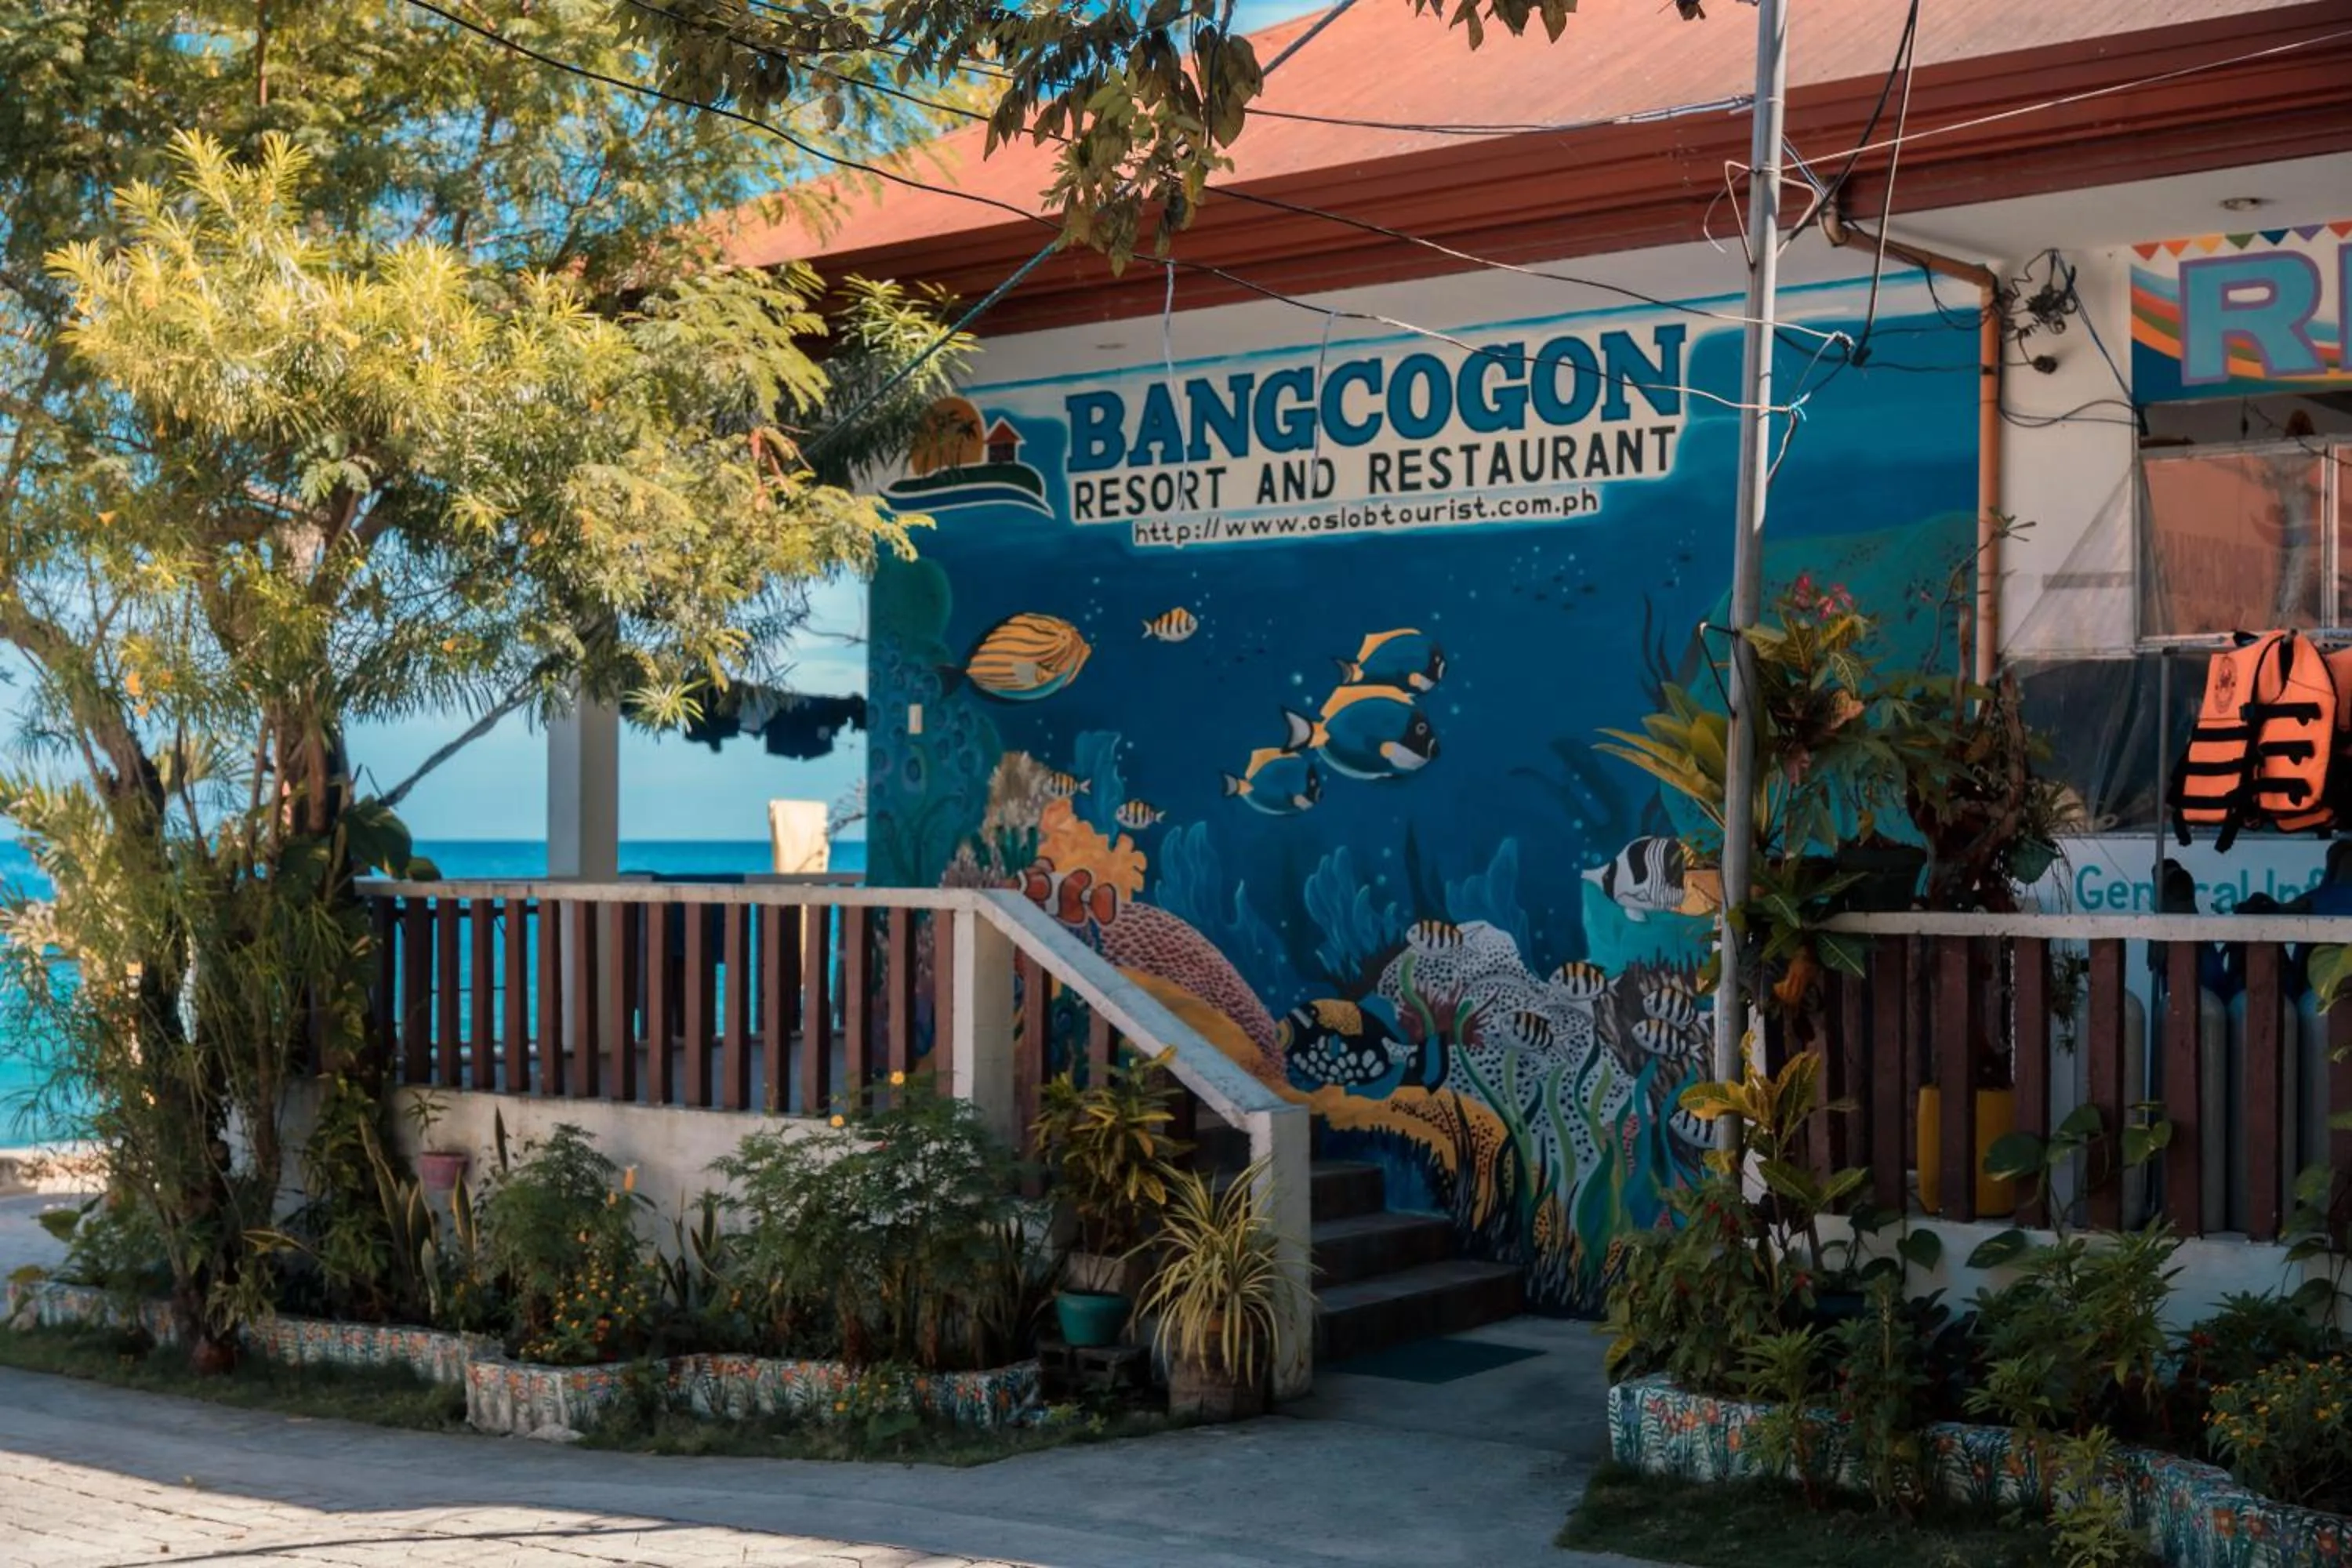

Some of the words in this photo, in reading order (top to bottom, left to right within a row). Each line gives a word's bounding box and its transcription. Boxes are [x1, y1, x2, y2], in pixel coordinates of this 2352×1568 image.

[2179, 244, 2352, 386] R
[1065, 323, 1686, 472] BANGCOGON
[1075, 466, 1227, 519] RESORT
[1257, 458, 1335, 504] AND
[1369, 426, 1675, 494] RESTAURANT
[1135, 488, 1598, 544] http://www.oslobtourist.com.ph
[2076, 865, 2249, 914] Genal
